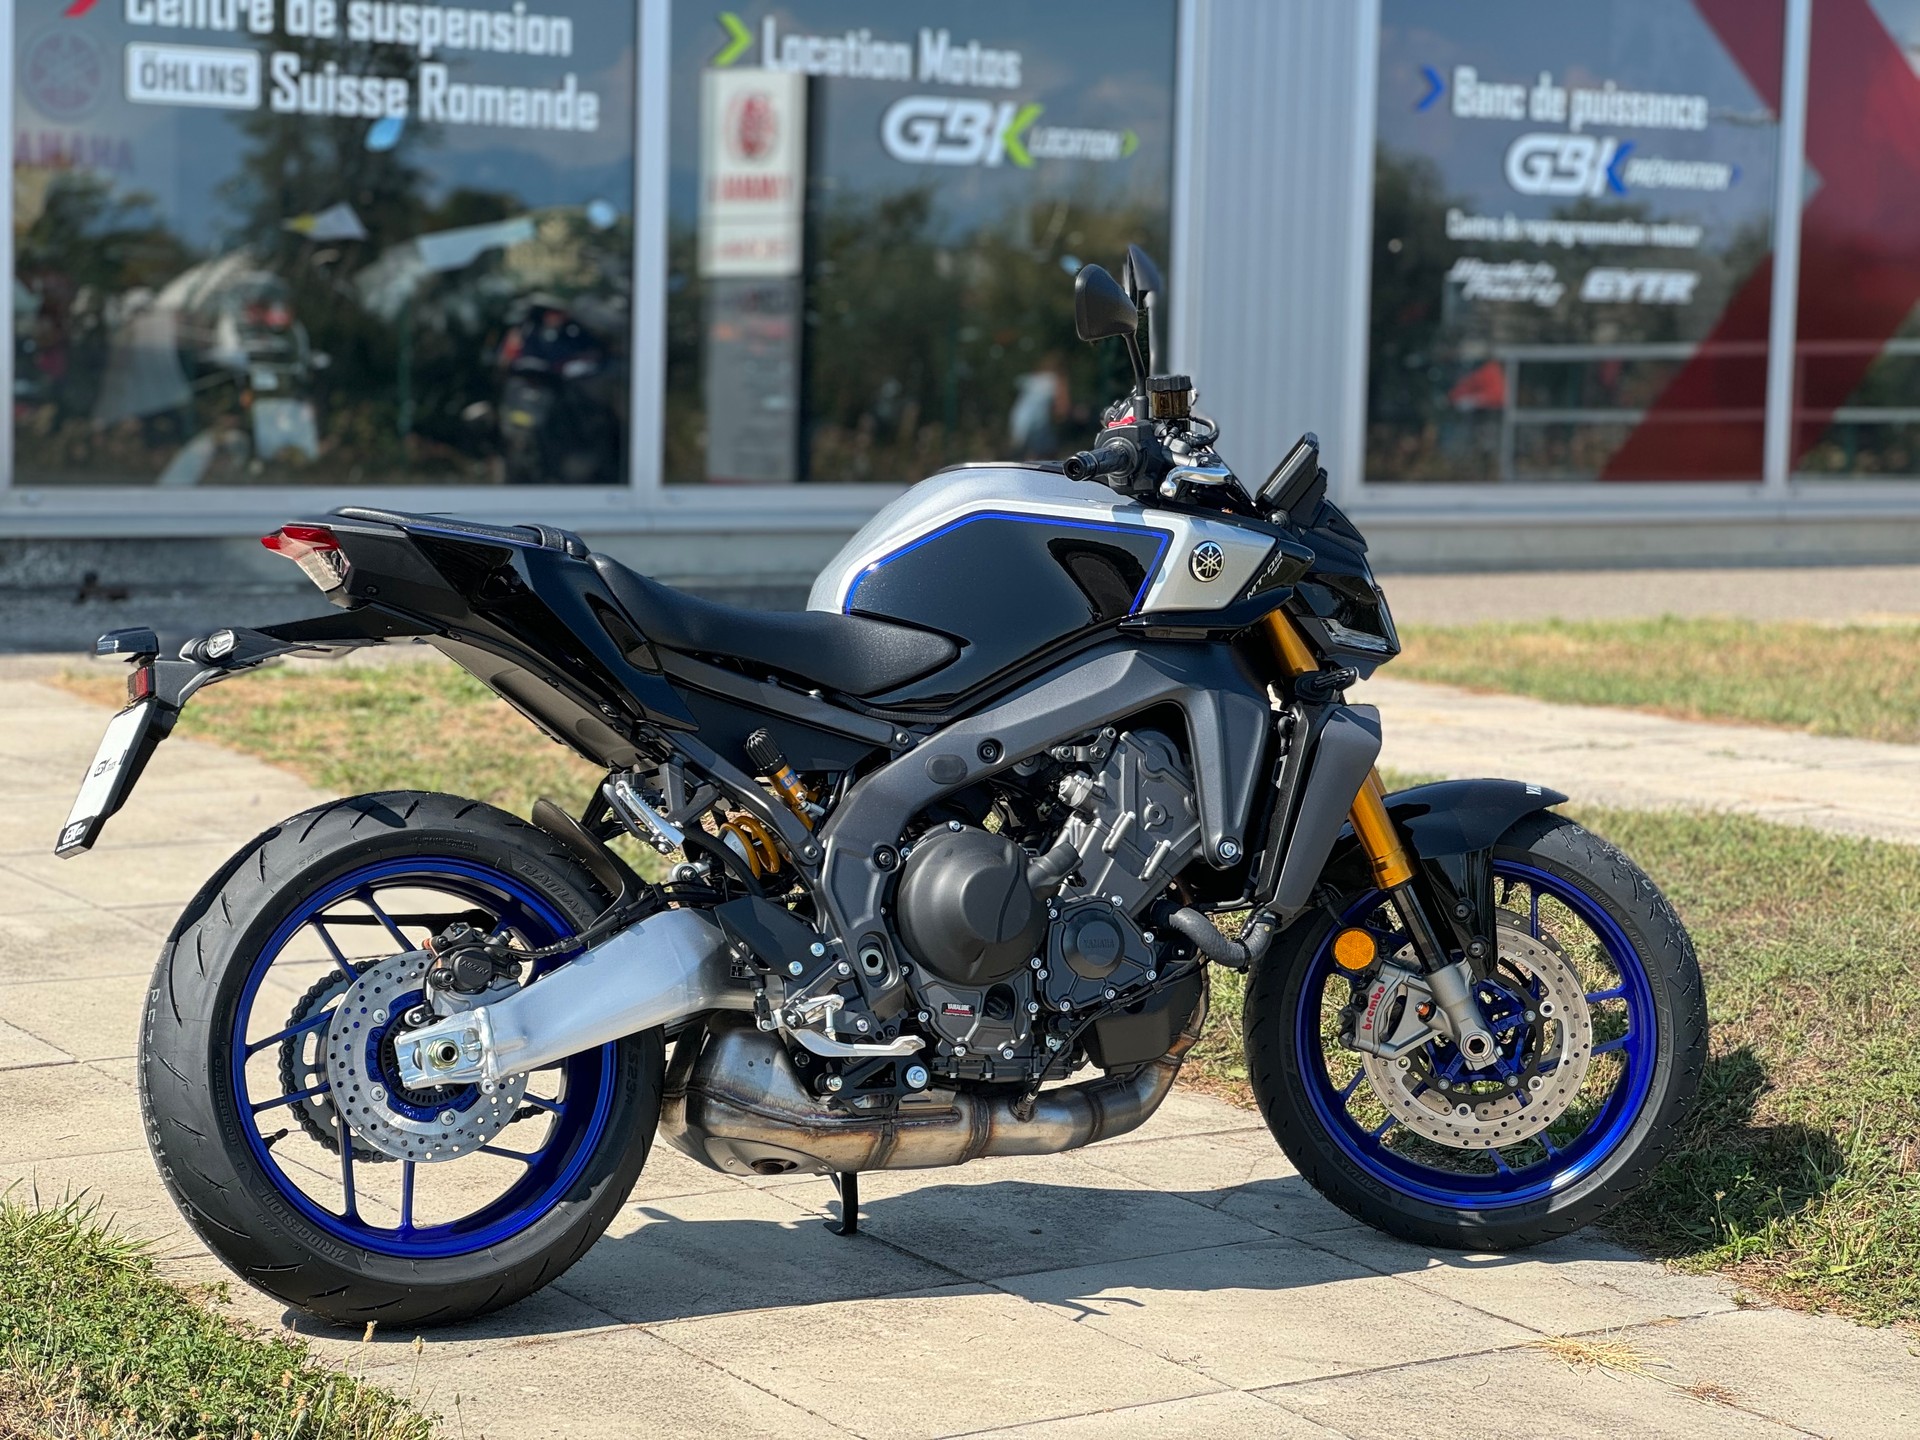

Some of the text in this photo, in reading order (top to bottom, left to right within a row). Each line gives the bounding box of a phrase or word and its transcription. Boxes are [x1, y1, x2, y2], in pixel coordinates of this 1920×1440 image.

[285, 0, 337, 39] de
[348, 0, 573, 58] suspension
[762, 16, 1023, 89] Location Motos
[140, 51, 600, 132] ÖHLINS Suisse Romande
[1452, 65, 1709, 133] Banc de puissance
[13, 129, 135, 173] AMAHA
[882, 95, 1124, 168] GBK LOCATION
[1505, 132, 1636, 198] GBK
[1579, 267, 1701, 304] GYTR
[1246, 550, 1283, 601] MT-09
[1361, 985, 1386, 1031] brembo
[255, 1186, 346, 1264] BRIDGESTONE
